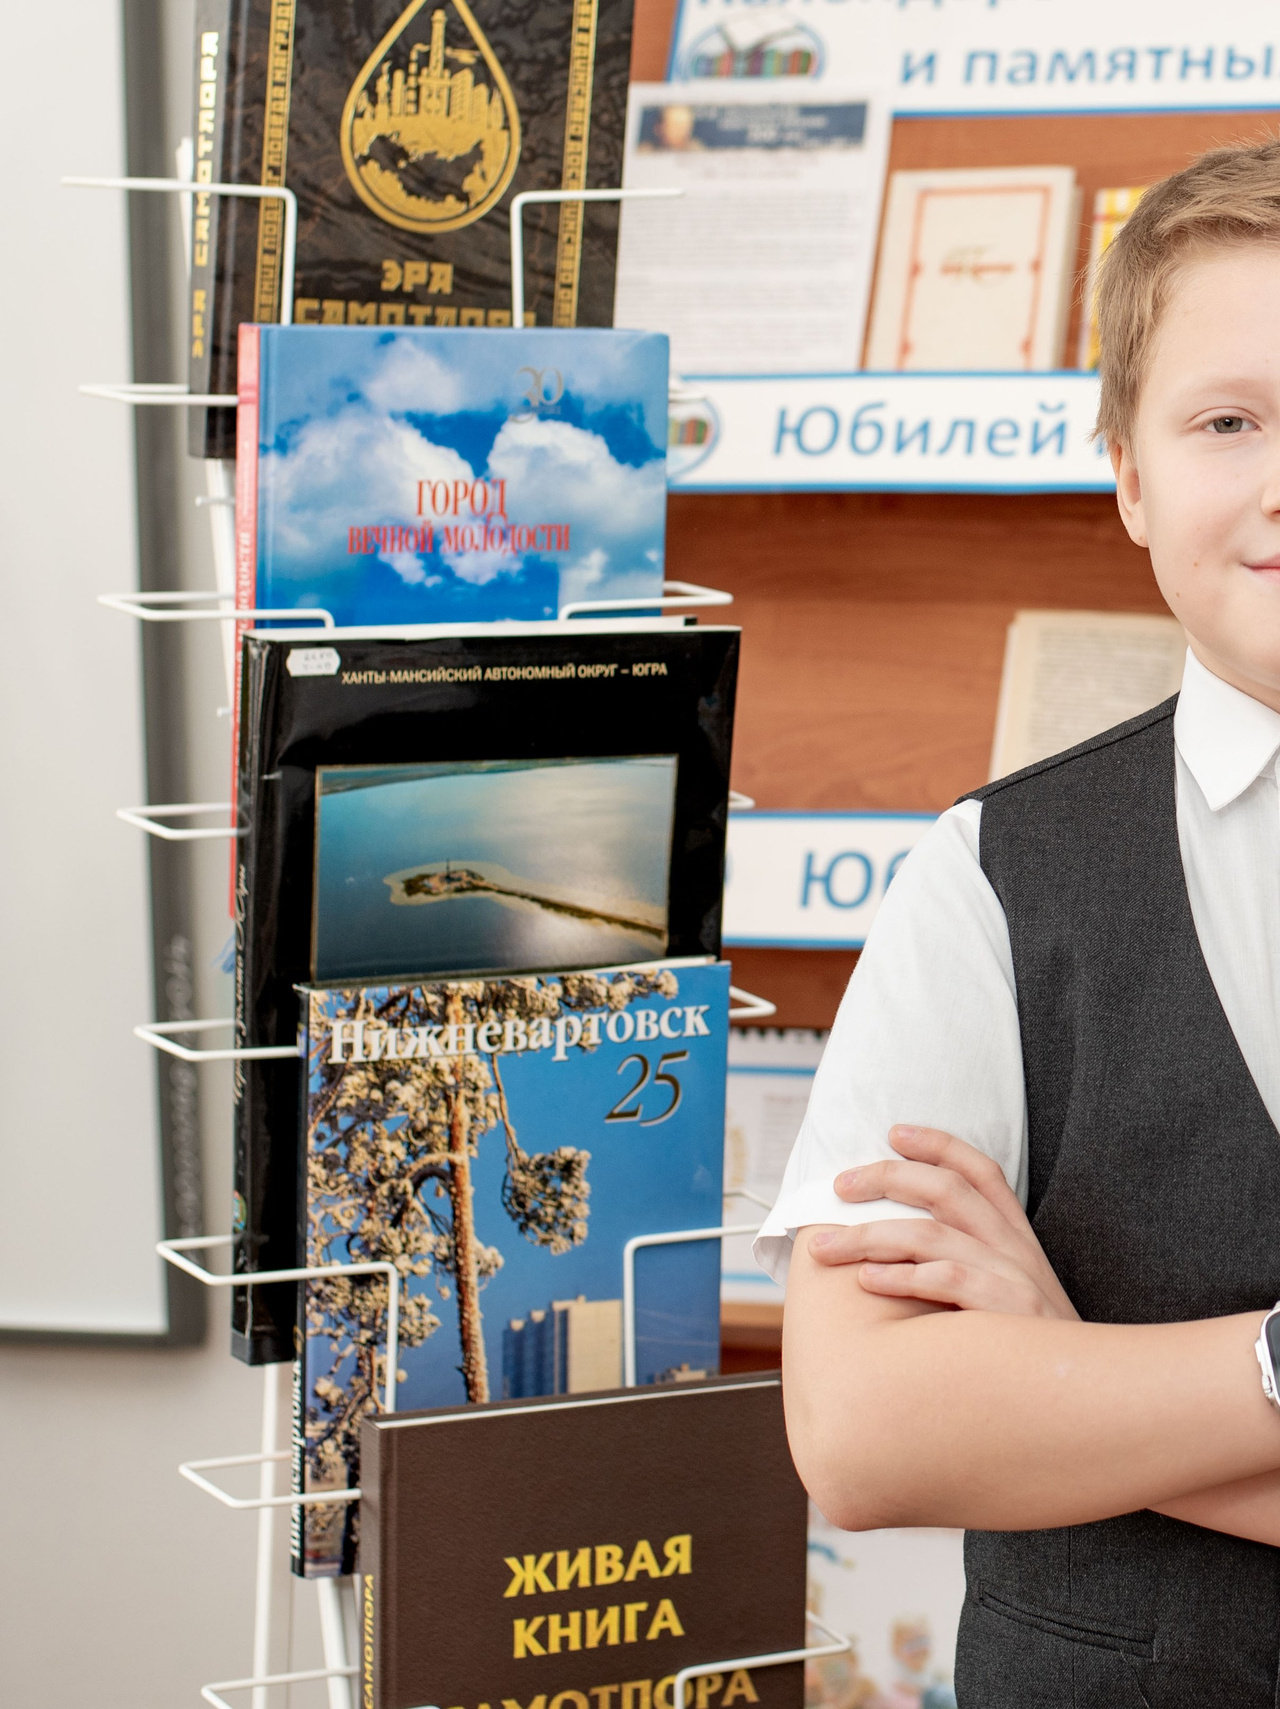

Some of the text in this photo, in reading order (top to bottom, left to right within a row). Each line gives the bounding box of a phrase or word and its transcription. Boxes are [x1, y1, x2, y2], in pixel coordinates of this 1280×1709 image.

[273, 0, 292, 82] НАГРАД
[900, 50, 938, 86] и
[380, 259, 454, 294] ЭРА
[192, 290, 207, 359] ЭРА
[772, 400, 1068, 458] Юбилей
[416, 478, 508, 523] ГОРОД
[347, 520, 571, 558] ВЕЧНОЙ МОЛОДОСТИ
[341, 665, 482, 685] ХАНТЫ-МАНСИЙСКИЙ
[484, 662, 576, 681] АВТОНОМНЫЙ
[577, 663, 619, 679] ОКРУГ
[632, 662, 668, 677] ЮГРА
[327, 1004, 711, 1065] Нижневартовск
[604, 1049, 690, 1127] 25
[503, 1534, 693, 1598] ЖИВАЯ
[513, 1598, 685, 1659] КНИГА
[446, 1669, 760, 1709] ОТЛОРА
